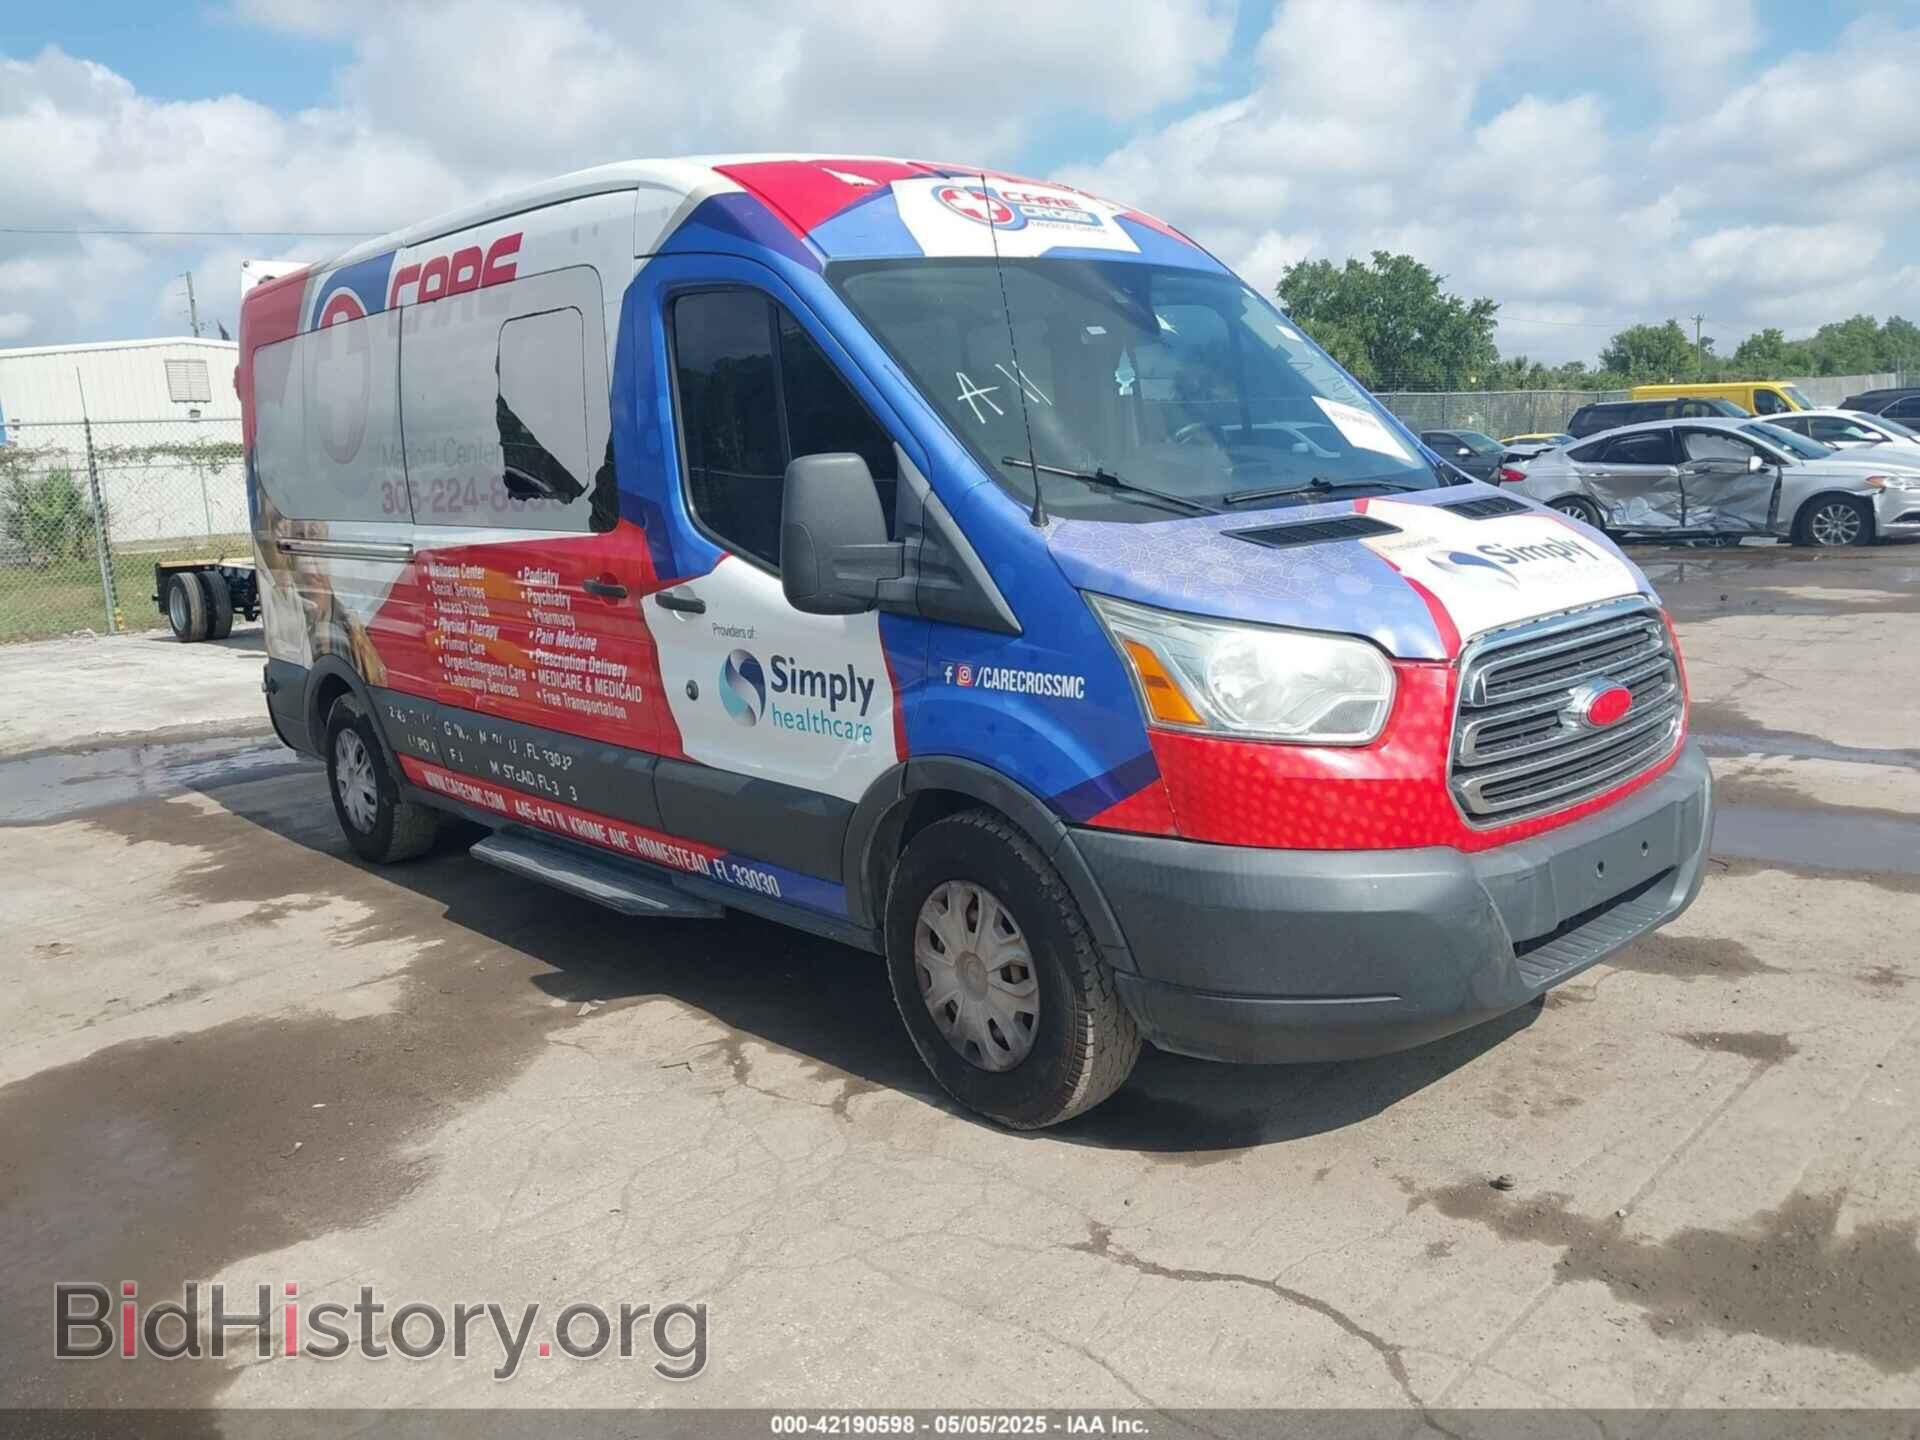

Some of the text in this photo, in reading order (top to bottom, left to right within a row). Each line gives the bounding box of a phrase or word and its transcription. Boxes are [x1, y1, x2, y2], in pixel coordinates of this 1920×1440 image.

[1476, 536, 1600, 565] Simply
[460, 563, 485, 579] Center
[453, 581, 485, 599] Services
[527, 587, 571, 611] Psychiatry
[469, 619, 499, 641] Therapy
[532, 608, 575, 631] Pharmacy
[712, 622, 746, 640] Providers
[469, 639, 486, 656] Care
[535, 627, 597, 652] Pain Medicine
[508, 663, 527, 682] Care
[535, 648, 628, 682] Prescription Delivery
[487, 678, 519, 698] Services
[538, 668, 642, 703] MEDICARE & MEDICAID
[770, 654, 875, 717] Simply
[975, 666, 1085, 699] /CARECROSSMC
[542, 688, 628, 720] Free Transportation
[771, 702, 873, 744] healthcare
[514, 800, 558, 828] 445-447
[568, 815, 609, 845] KROME
[713, 859, 735, 884] FL
[731, 863, 782, 899] 33030
